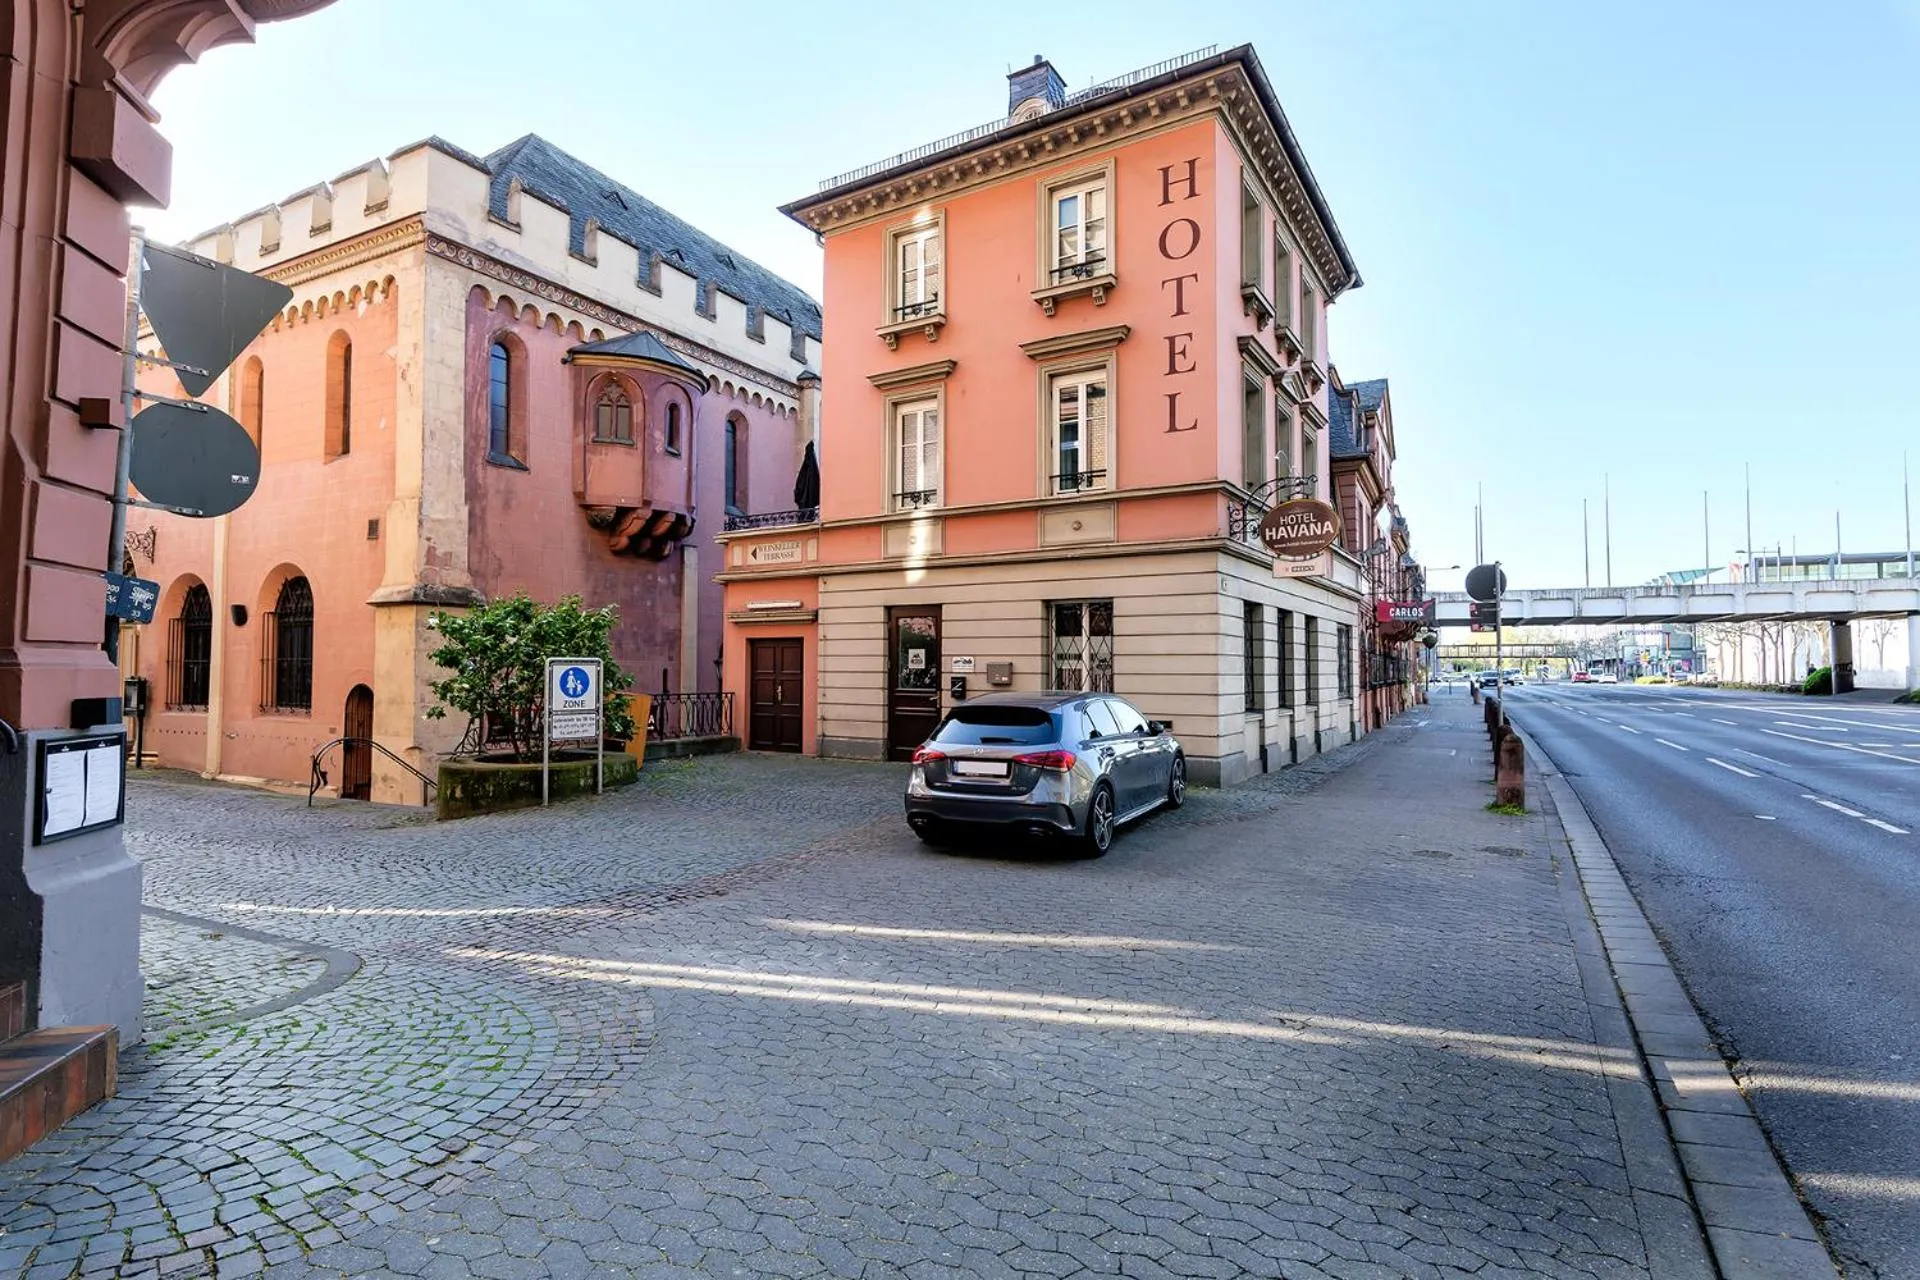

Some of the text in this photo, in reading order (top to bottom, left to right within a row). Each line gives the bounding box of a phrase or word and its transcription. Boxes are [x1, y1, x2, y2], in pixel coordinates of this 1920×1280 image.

[1157, 156, 1202, 434] HOTEL
[1280, 512, 1317, 525] HOTEL
[1265, 520, 1335, 541] HAVANA
[763, 551, 795, 561] TERRASSE
[1389, 607, 1425, 617] CARLOS
[563, 699, 587, 708] ZONE
